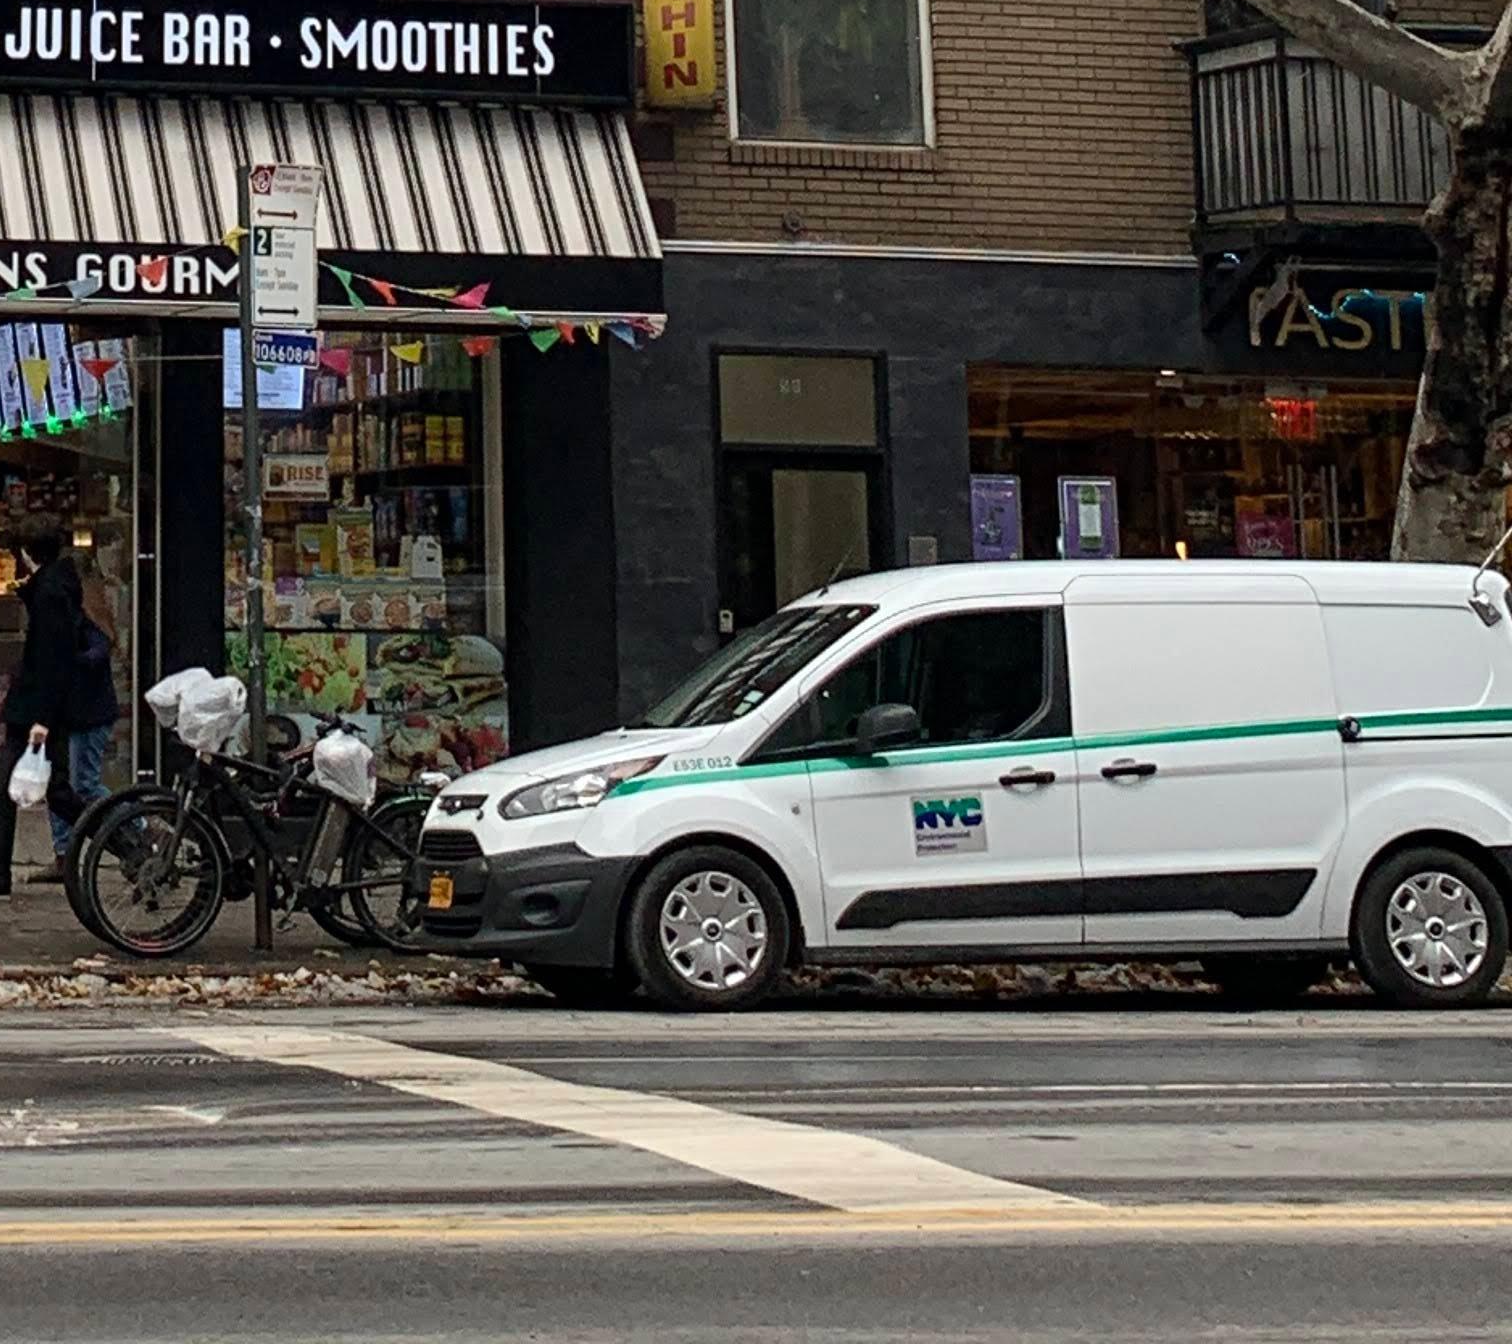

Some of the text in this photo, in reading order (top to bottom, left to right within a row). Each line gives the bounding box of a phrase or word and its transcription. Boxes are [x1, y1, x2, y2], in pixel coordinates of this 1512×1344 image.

[5, 7, 143, 63] JUICE
[163, 12, 250, 66] BAR
[300, 17, 554, 76] SMOOTHIES
[257, 229, 267, 254] 2
[77, 254, 241, 294] GOURM
[287, 465, 325, 481] RISE
[707, 755, 733, 769] 012
[913, 797, 983, 830] NYC
